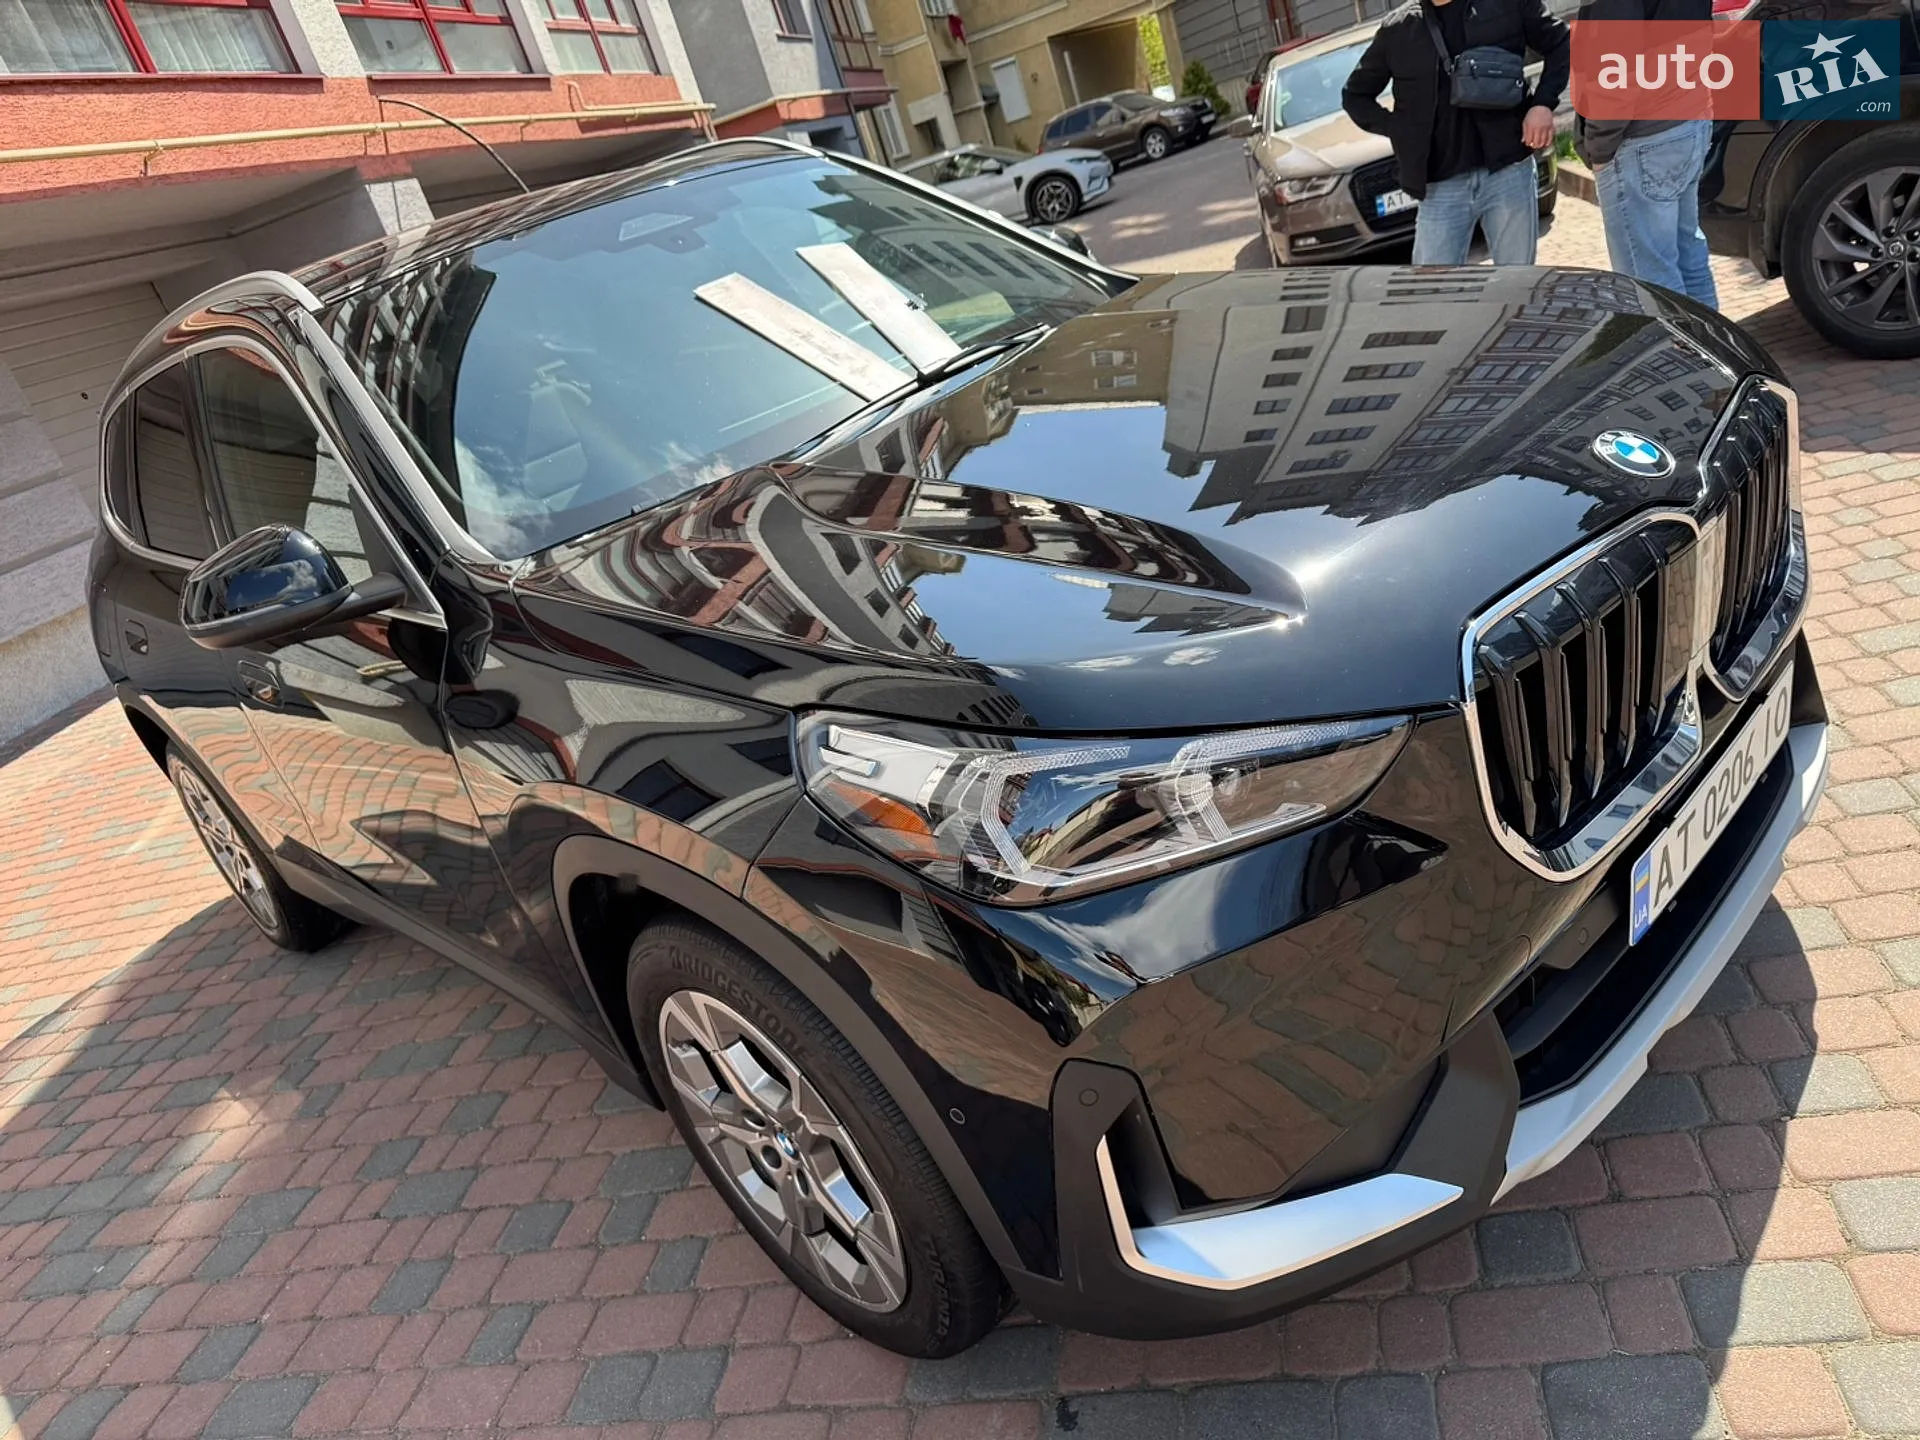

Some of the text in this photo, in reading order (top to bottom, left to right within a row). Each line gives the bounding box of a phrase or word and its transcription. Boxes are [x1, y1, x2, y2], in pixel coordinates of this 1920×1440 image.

[1653, 808, 1696, 908] AT
[1703, 729, 1755, 840] 0206
[1634, 903, 1649, 929] UA
